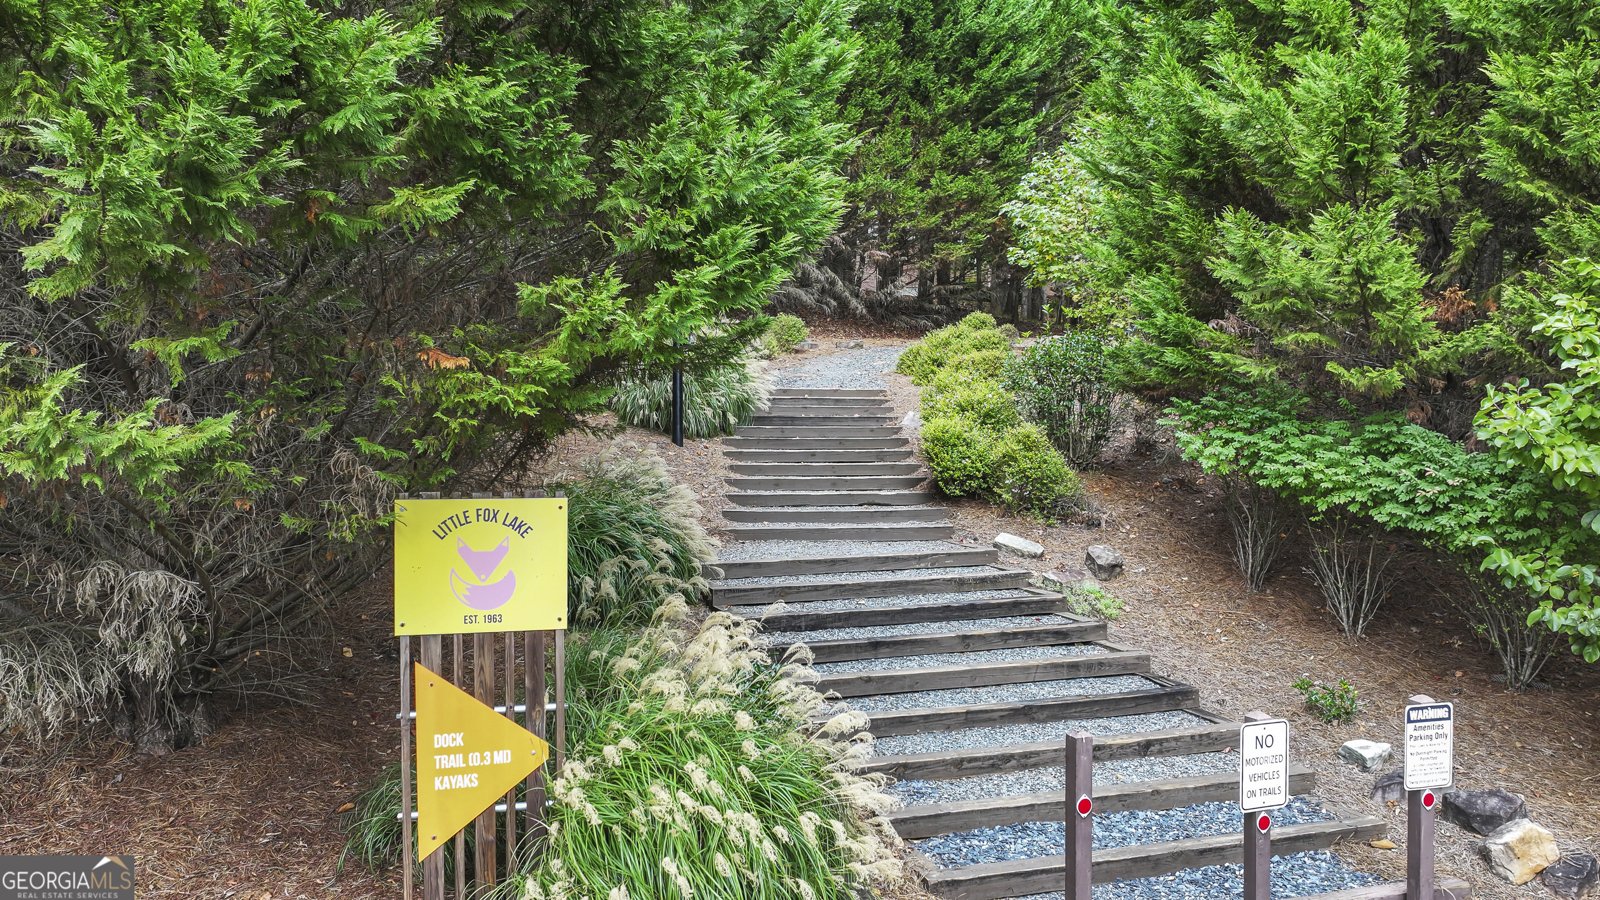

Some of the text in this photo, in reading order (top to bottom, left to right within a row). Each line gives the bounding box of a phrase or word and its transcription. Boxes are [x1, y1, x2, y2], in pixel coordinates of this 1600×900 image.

[432, 508, 534, 540] LITTLE FOX LAKE
[463, 613, 503, 625] EST. 1963
[1409, 707, 1449, 721] WARNING
[1413, 723, 1445, 732] Amenities
[433, 732, 464, 748] DOCK
[1255, 734, 1274, 750] NO
[1409, 731, 1449, 742] Parking Only
[433, 753, 466, 770] TRAIL
[1245, 754, 1284, 767] MOTORIZED
[434, 773, 479, 791] KAYAKS
[1248, 770, 1281, 783] VEHICLES
[1246, 786, 1282, 799] ON TRAILS
